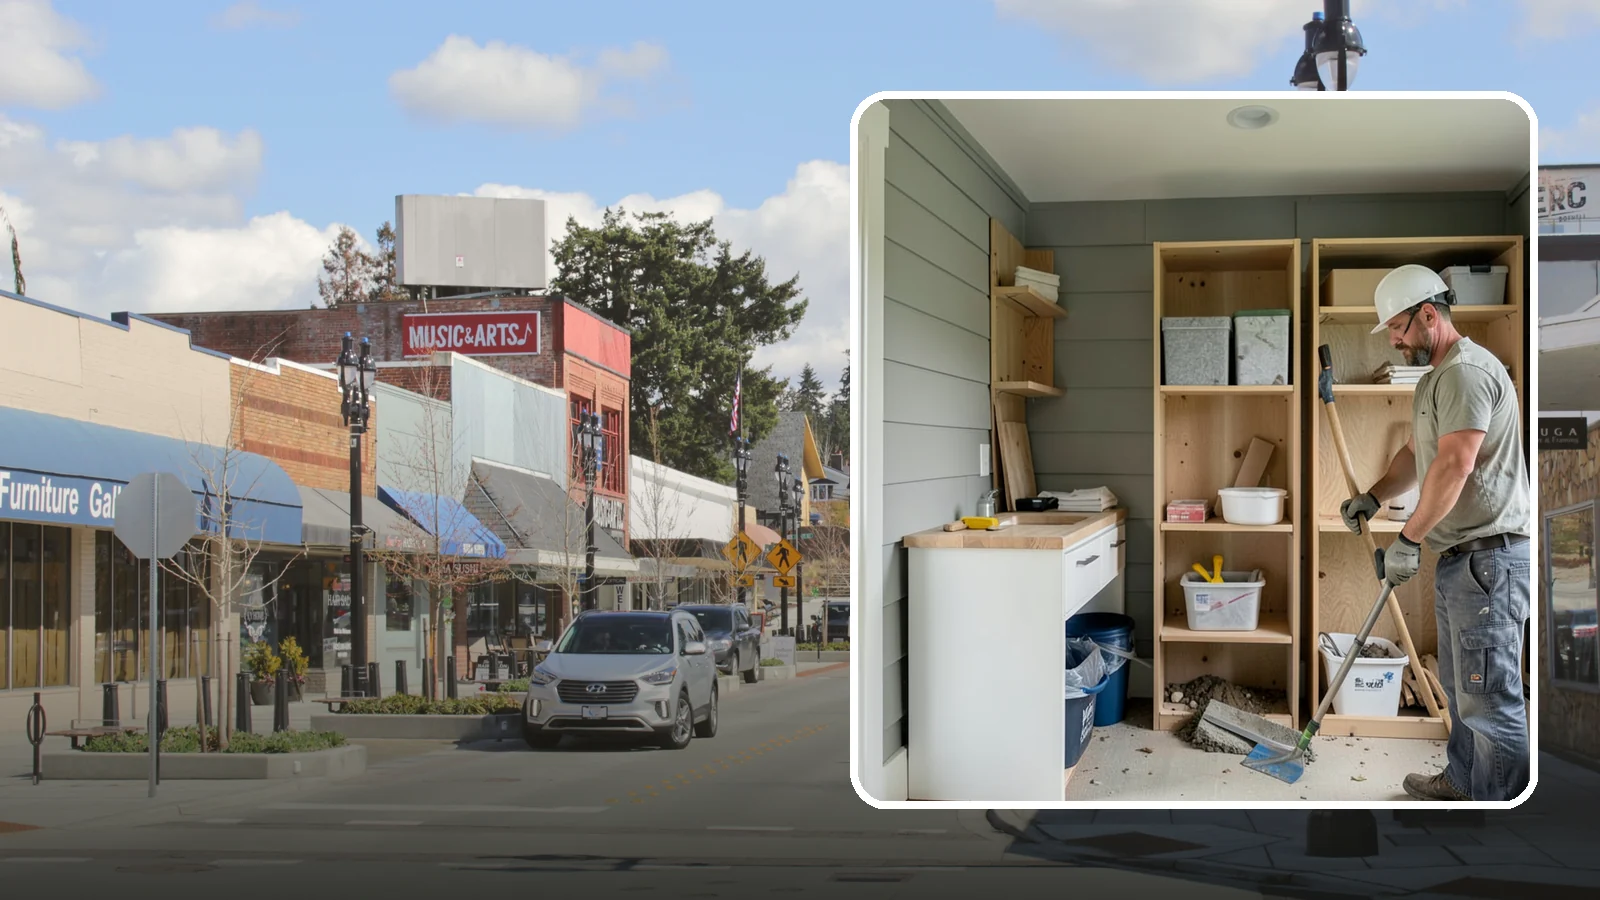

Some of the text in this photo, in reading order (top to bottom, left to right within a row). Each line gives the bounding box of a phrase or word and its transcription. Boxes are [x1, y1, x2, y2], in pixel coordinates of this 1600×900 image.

[409, 323, 519, 349] MUSIC&ARTS
[0, 472, 122, 519] Furniture Gal
